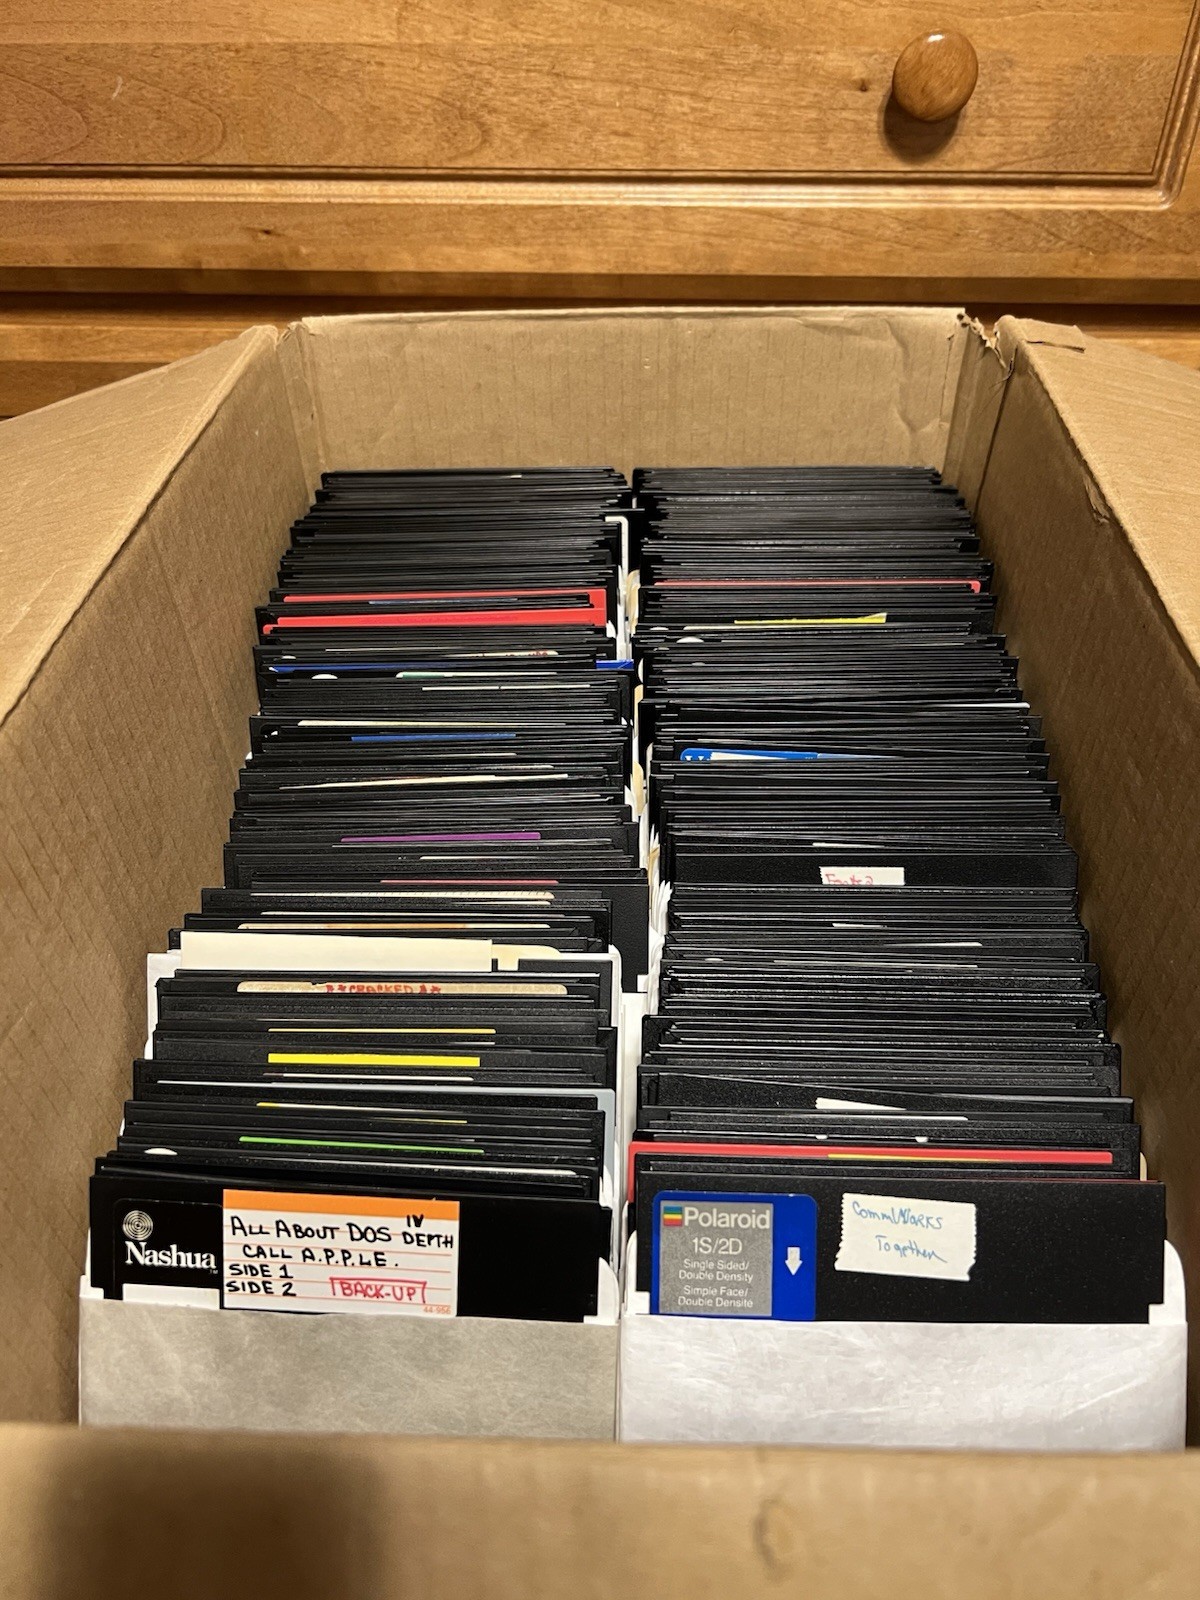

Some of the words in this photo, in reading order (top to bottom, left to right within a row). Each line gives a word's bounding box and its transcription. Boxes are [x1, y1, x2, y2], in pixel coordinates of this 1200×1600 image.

[684, 1207, 770, 1229] Polaroid
[275, 1219, 340, 1240] ABOUT
[346, 1222, 392, 1243] DOS
[401, 1231, 454, 1248] DEPTH
[243, 1244, 292, 1259] CALL
[692, 1237, 743, 1255] 1S/2D
[125, 1241, 216, 1270] Nashua
[229, 1264, 272, 1278] SIDE
[279, 1264, 294, 1279] 1
[683, 1259, 715, 1271] Single
[717, 1260, 749, 1270] Sided/
[679, 1270, 714, 1280] Double
[716, 1271, 754, 1284] Density
[226, 1280, 274, 1295] SIDE
[282, 1282, 297, 1297] 2
[340, 1280, 417, 1301] BACK-UP
[683, 1285, 718, 1297] Simple
[720, 1286, 749, 1297] Face/
[678, 1298, 713, 1307] Double
